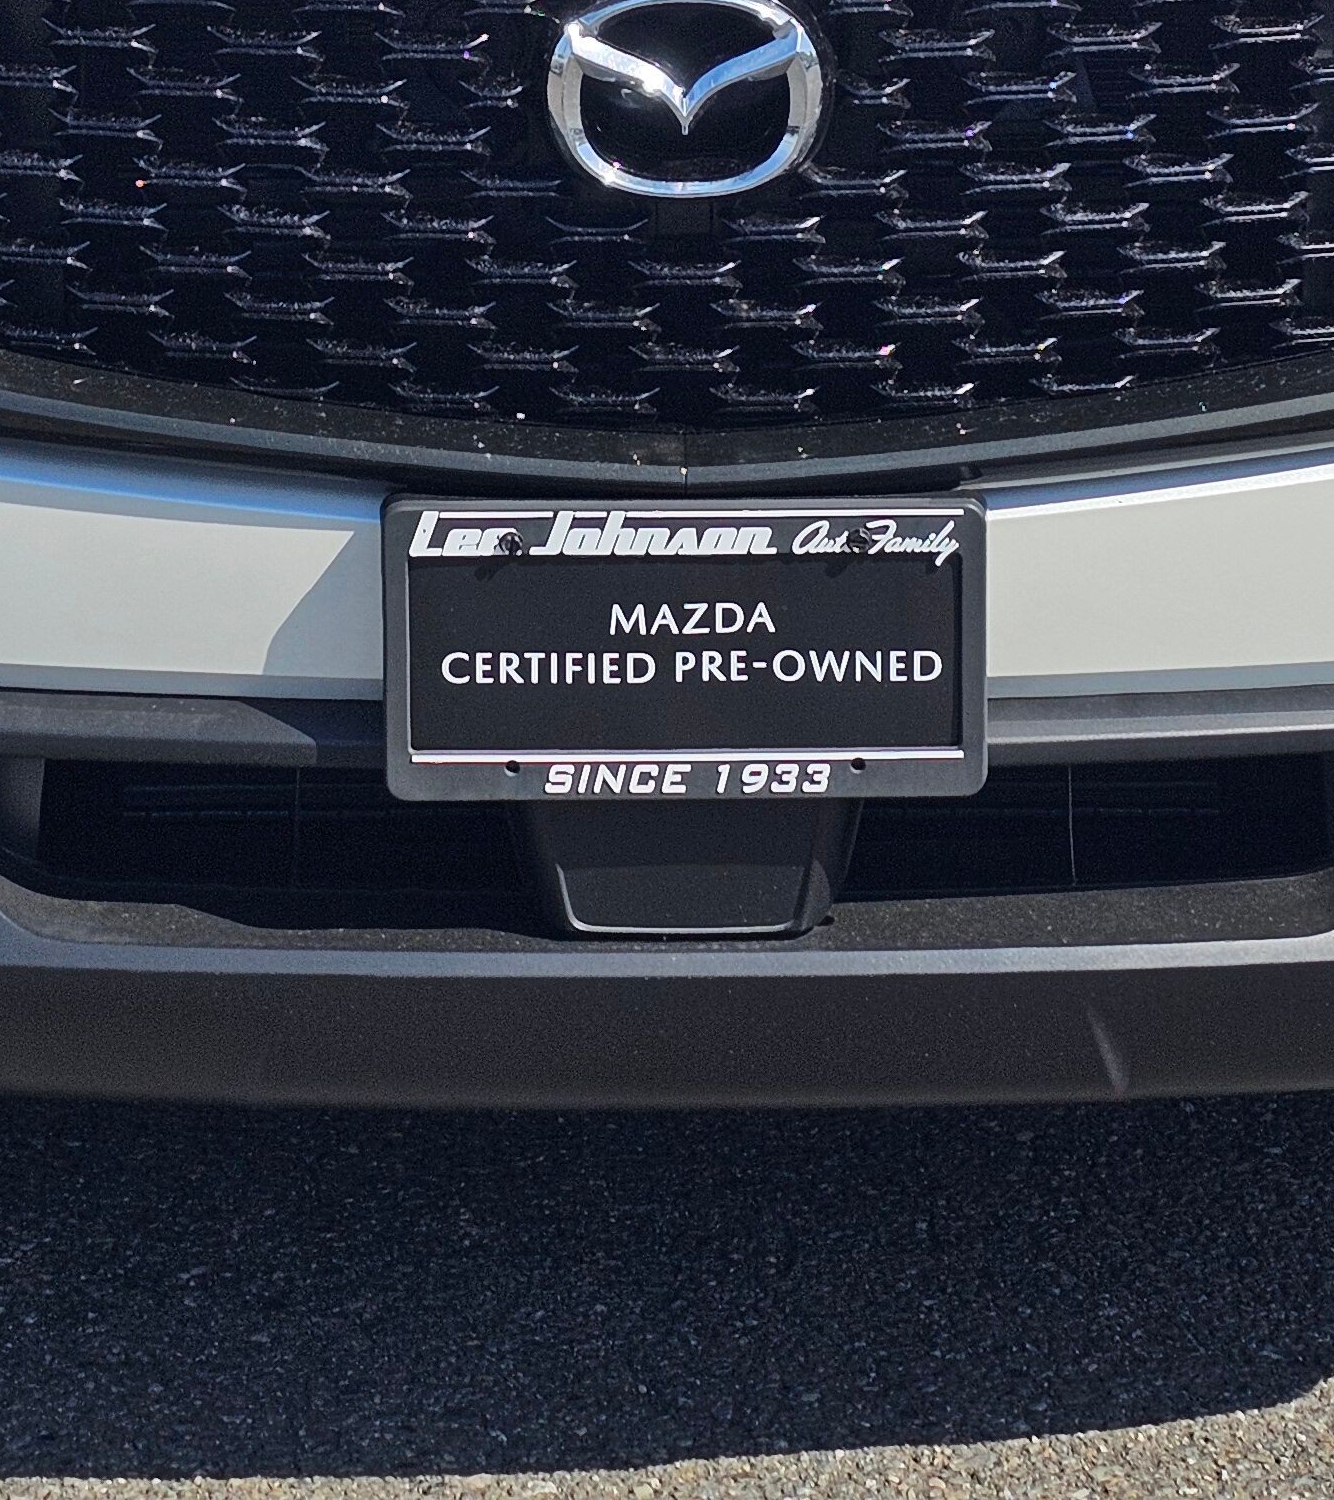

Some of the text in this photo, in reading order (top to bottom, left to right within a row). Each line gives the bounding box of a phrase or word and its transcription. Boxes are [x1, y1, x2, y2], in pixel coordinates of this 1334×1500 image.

[529, 510, 777, 556] Johnson
[791, 519, 869, 555] Aut
[865, 519, 960, 567] Family
[609, 602, 776, 635] MAZDA
[441, 649, 942, 684] CERTIFIED PRE-OWNED
[544, 763, 831, 795] SINCE 1933
